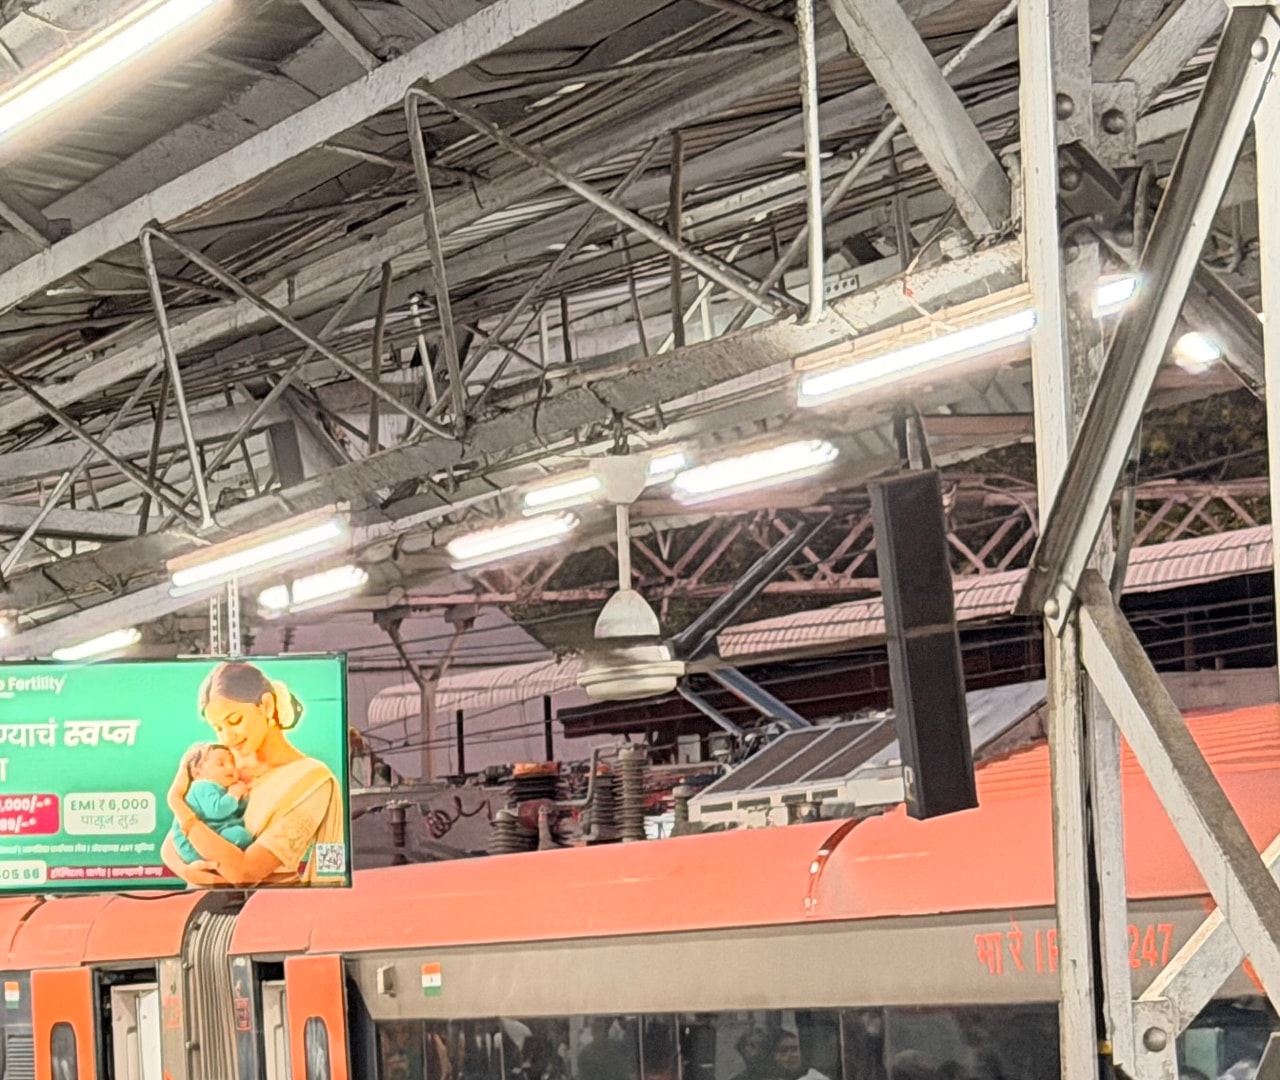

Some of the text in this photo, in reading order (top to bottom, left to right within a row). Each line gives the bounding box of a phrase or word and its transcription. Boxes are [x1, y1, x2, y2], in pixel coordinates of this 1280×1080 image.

[8, 673, 67, 694] Fertility
[63, 719, 141, 747] स्वप्न
[70, 799, 95, 811] EMI
